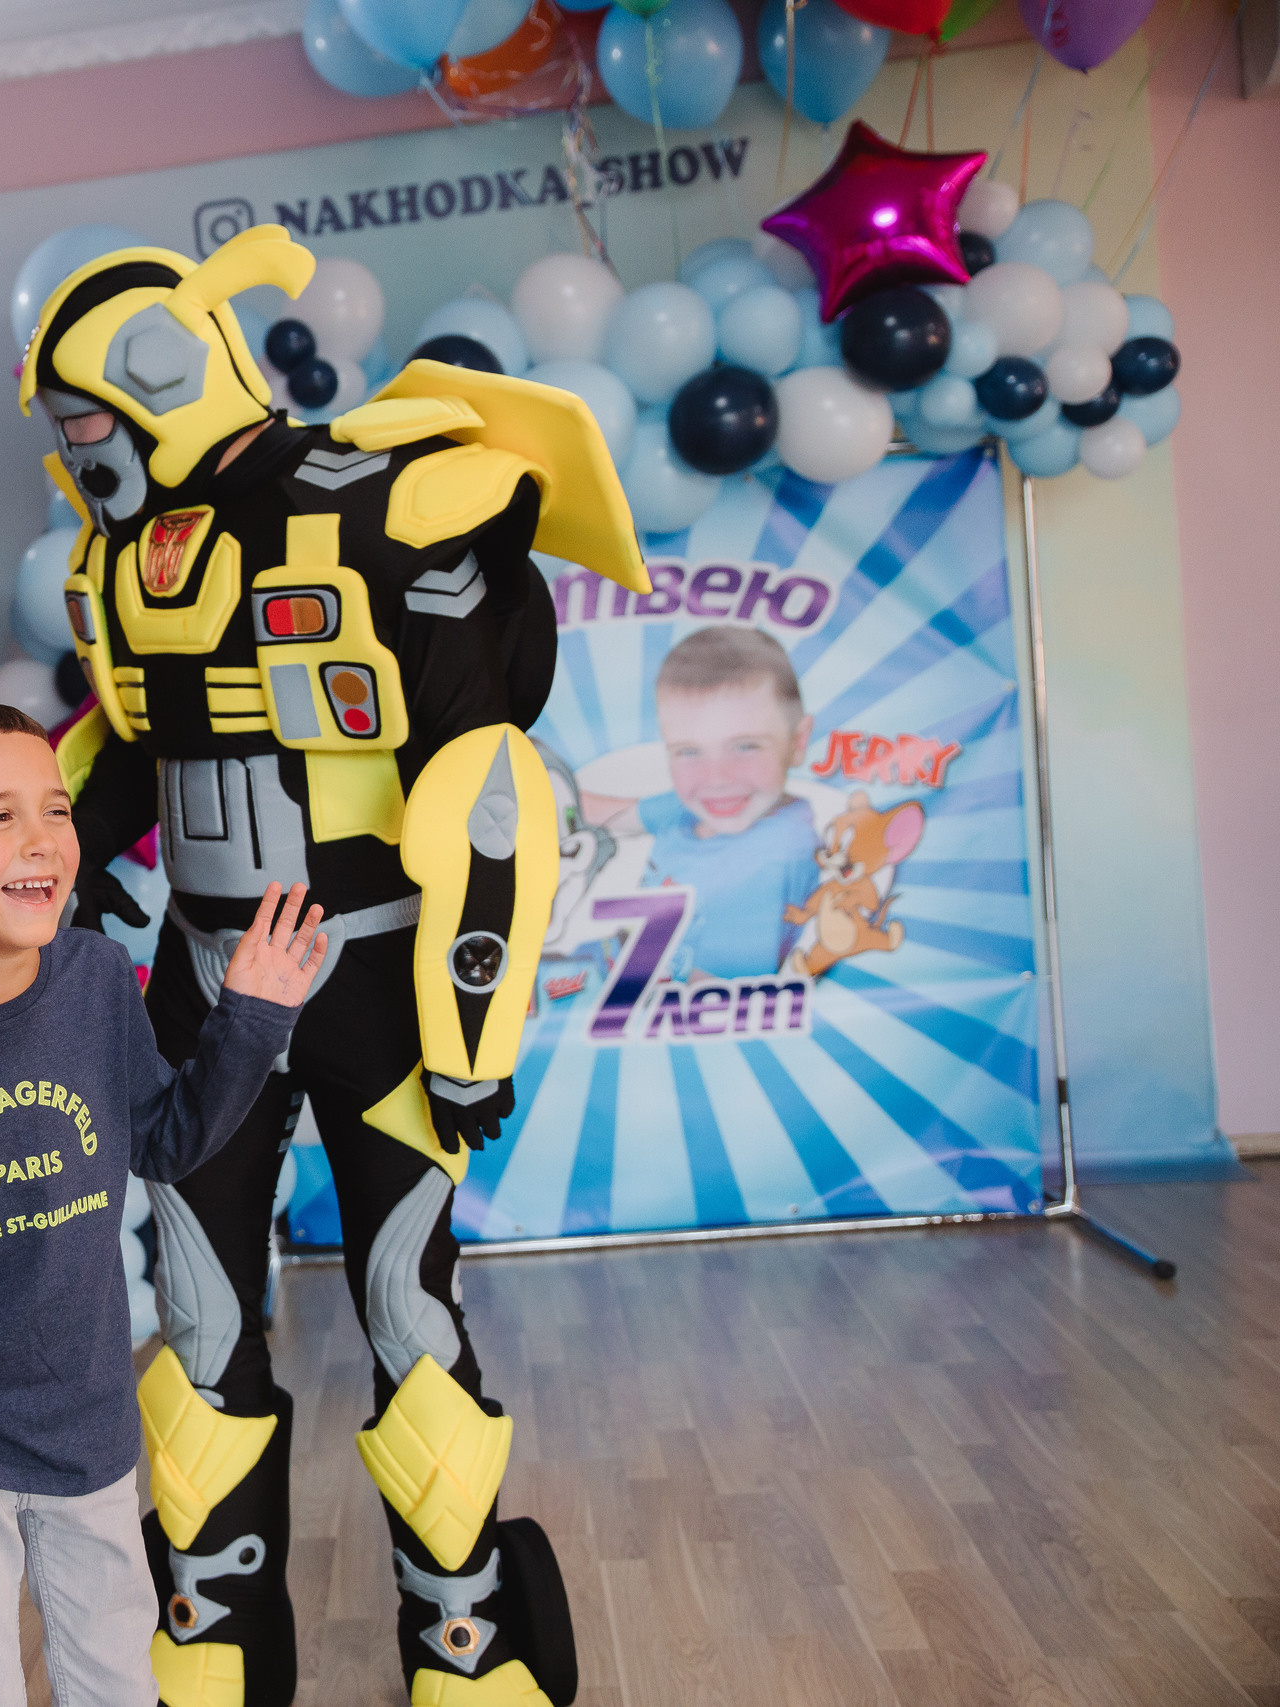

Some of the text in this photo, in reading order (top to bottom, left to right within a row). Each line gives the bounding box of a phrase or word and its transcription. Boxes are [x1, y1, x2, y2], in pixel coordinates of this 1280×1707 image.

[554, 564, 830, 629] твею
[811, 730, 962, 788] JERRY
[590, 893, 807, 1038] 7 лет
[7, 1191, 108, 1234] ST-GUILLAUME
